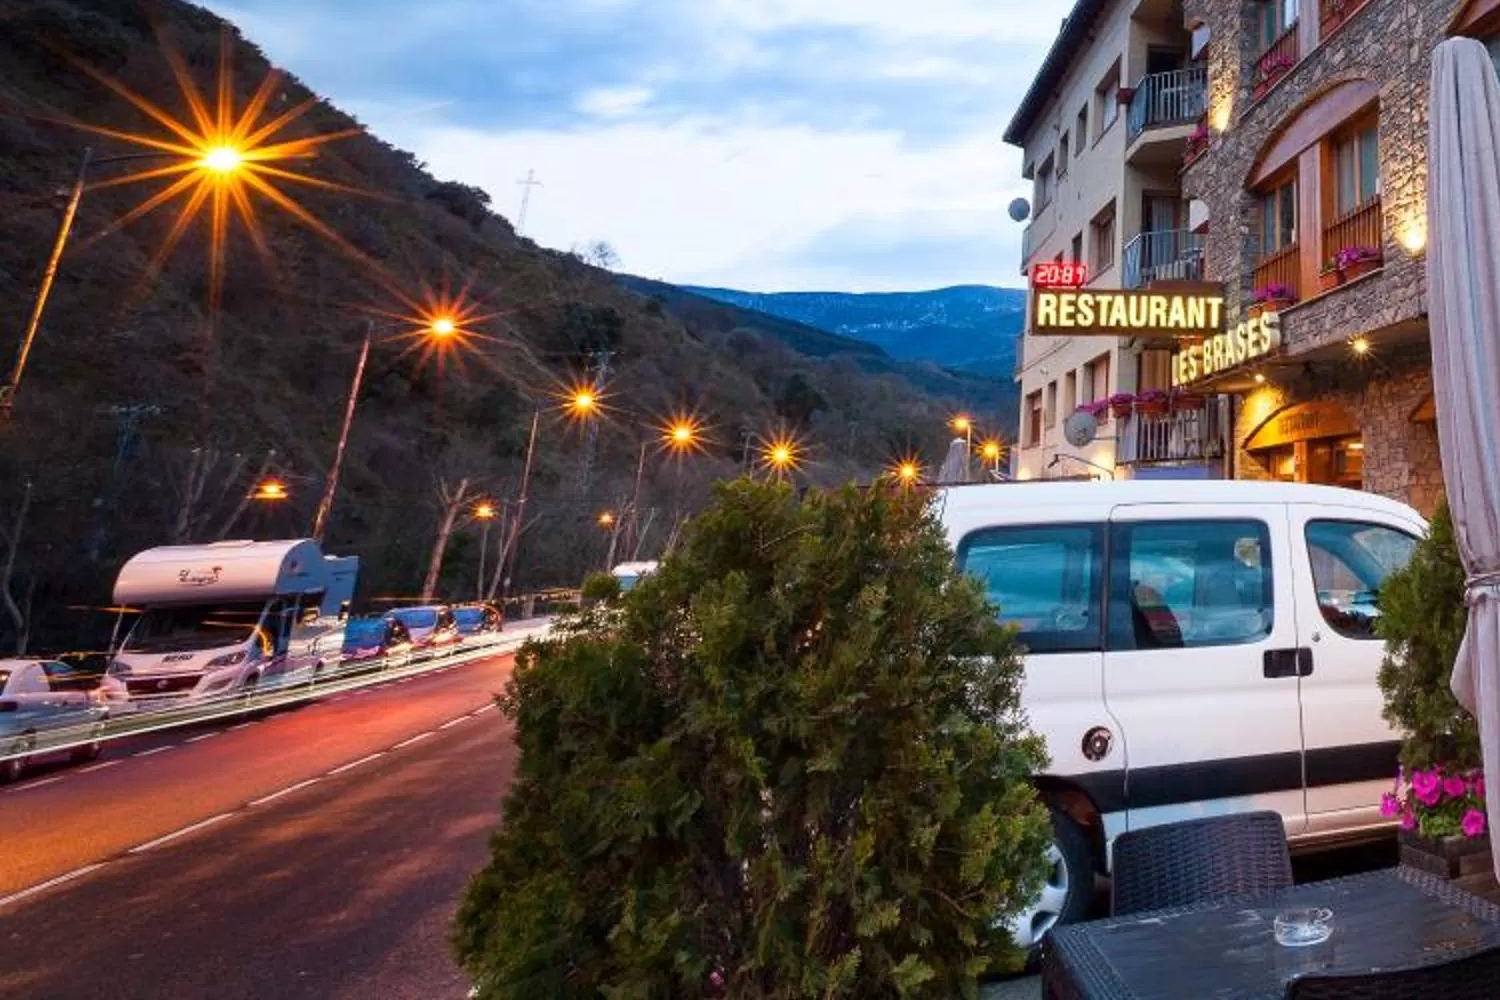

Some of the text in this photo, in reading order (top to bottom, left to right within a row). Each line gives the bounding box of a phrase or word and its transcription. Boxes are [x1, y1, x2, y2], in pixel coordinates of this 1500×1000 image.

[1037, 292, 1223, 329] RESTAURANT
[1172, 311, 1281, 387] LES BRASES
